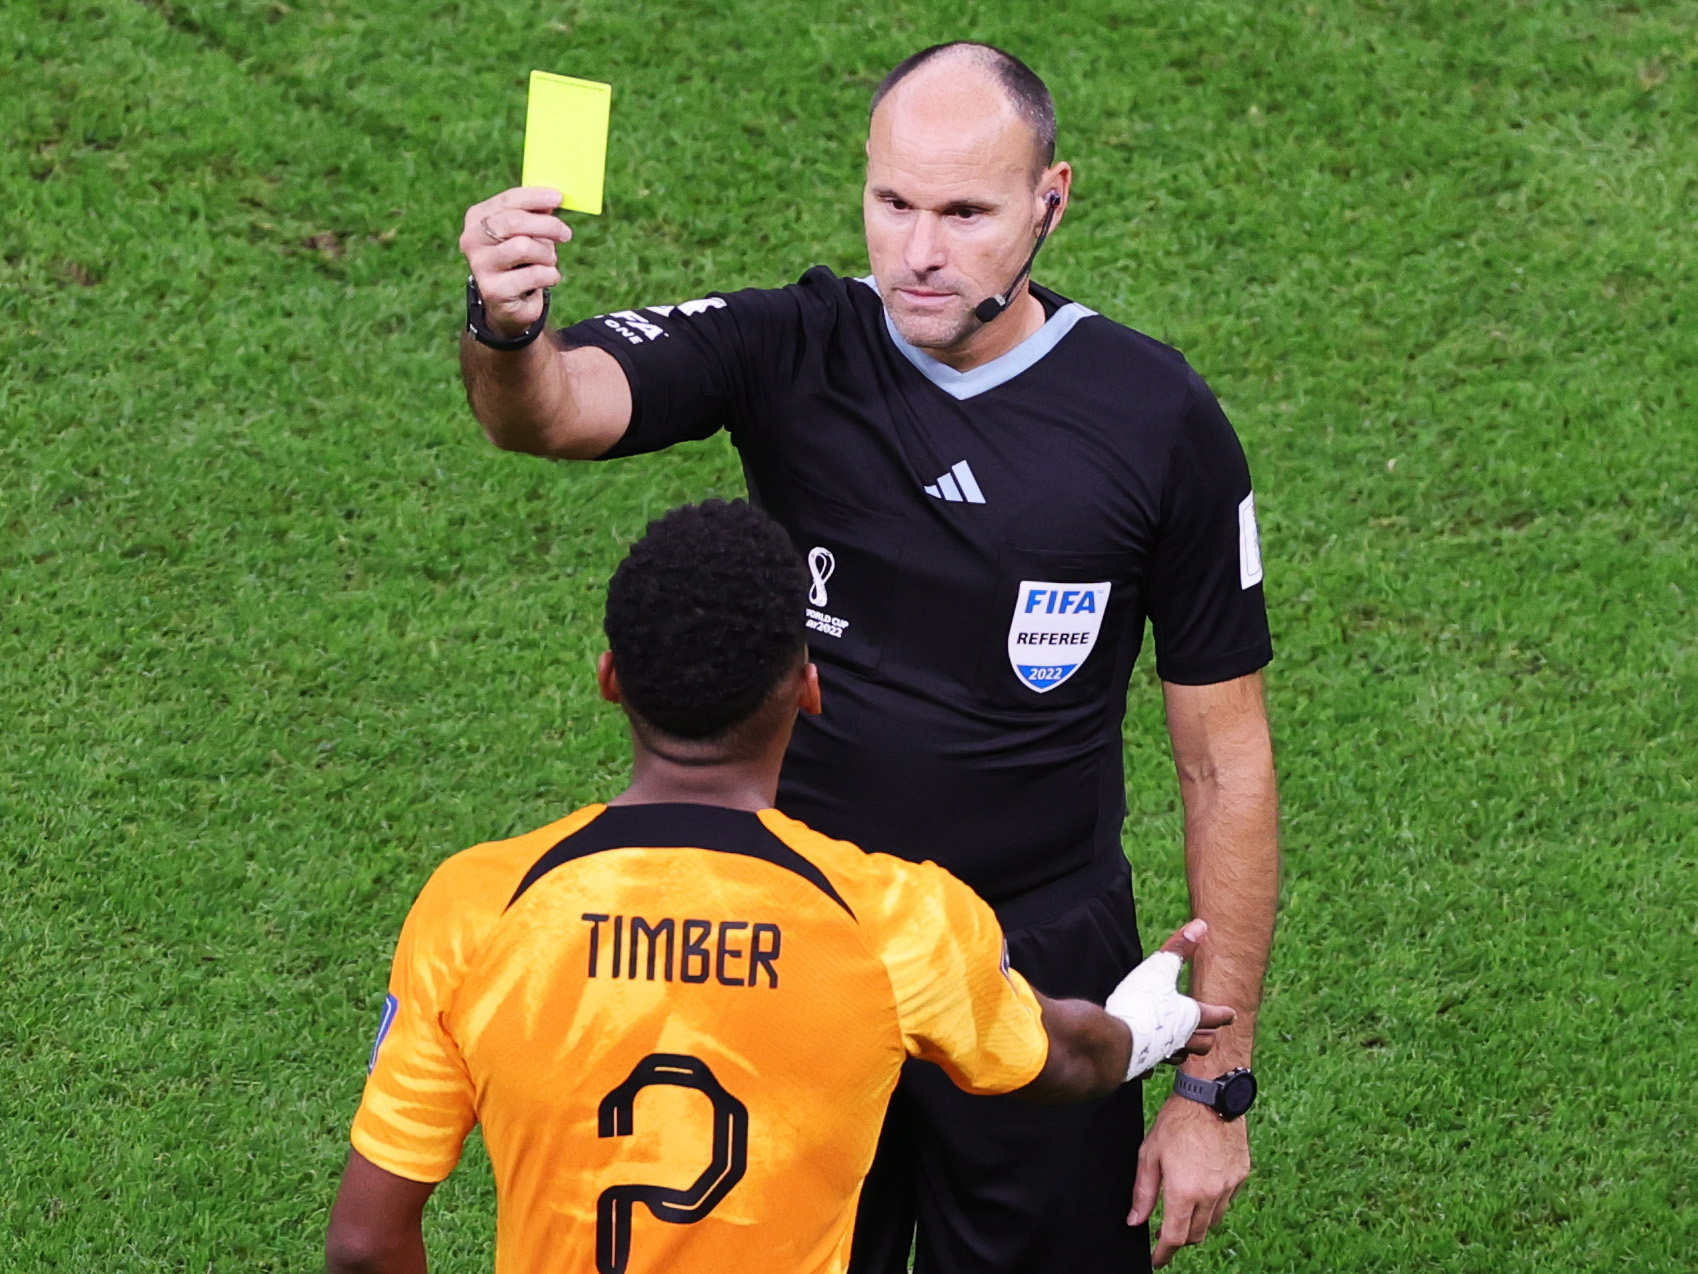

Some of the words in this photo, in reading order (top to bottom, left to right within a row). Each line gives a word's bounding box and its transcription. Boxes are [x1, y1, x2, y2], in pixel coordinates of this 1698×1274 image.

[1024, 589, 1096, 614] FIFA
[1016, 632, 1090, 645] REFEREE
[1028, 667, 1063, 680] 2022
[581, 913, 781, 989] TIMBER
